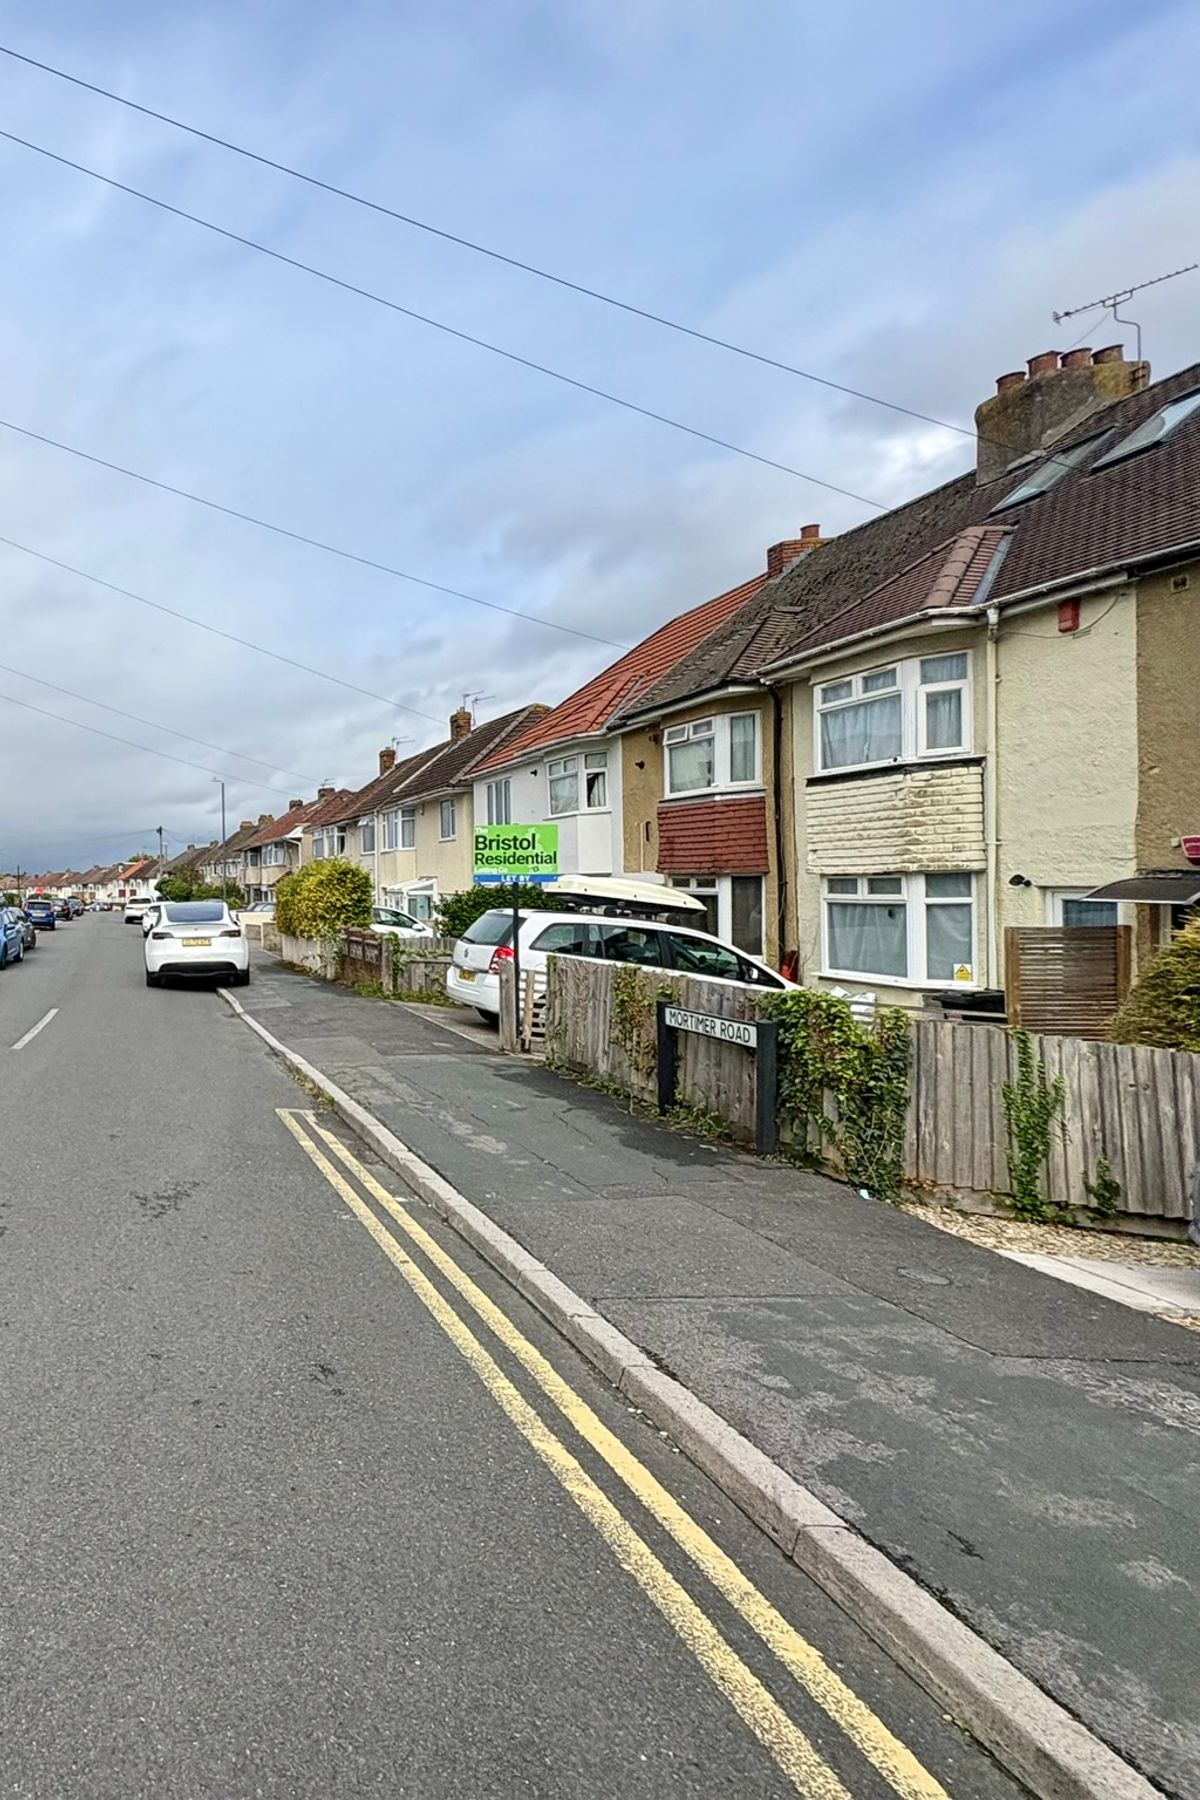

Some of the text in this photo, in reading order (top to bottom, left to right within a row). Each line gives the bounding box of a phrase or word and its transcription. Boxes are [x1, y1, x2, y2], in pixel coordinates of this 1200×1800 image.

[474, 833, 536, 851] Bristol
[474, 851, 557, 865] Residential
[669, 1010, 751, 1043] MORTIMER ROAD
